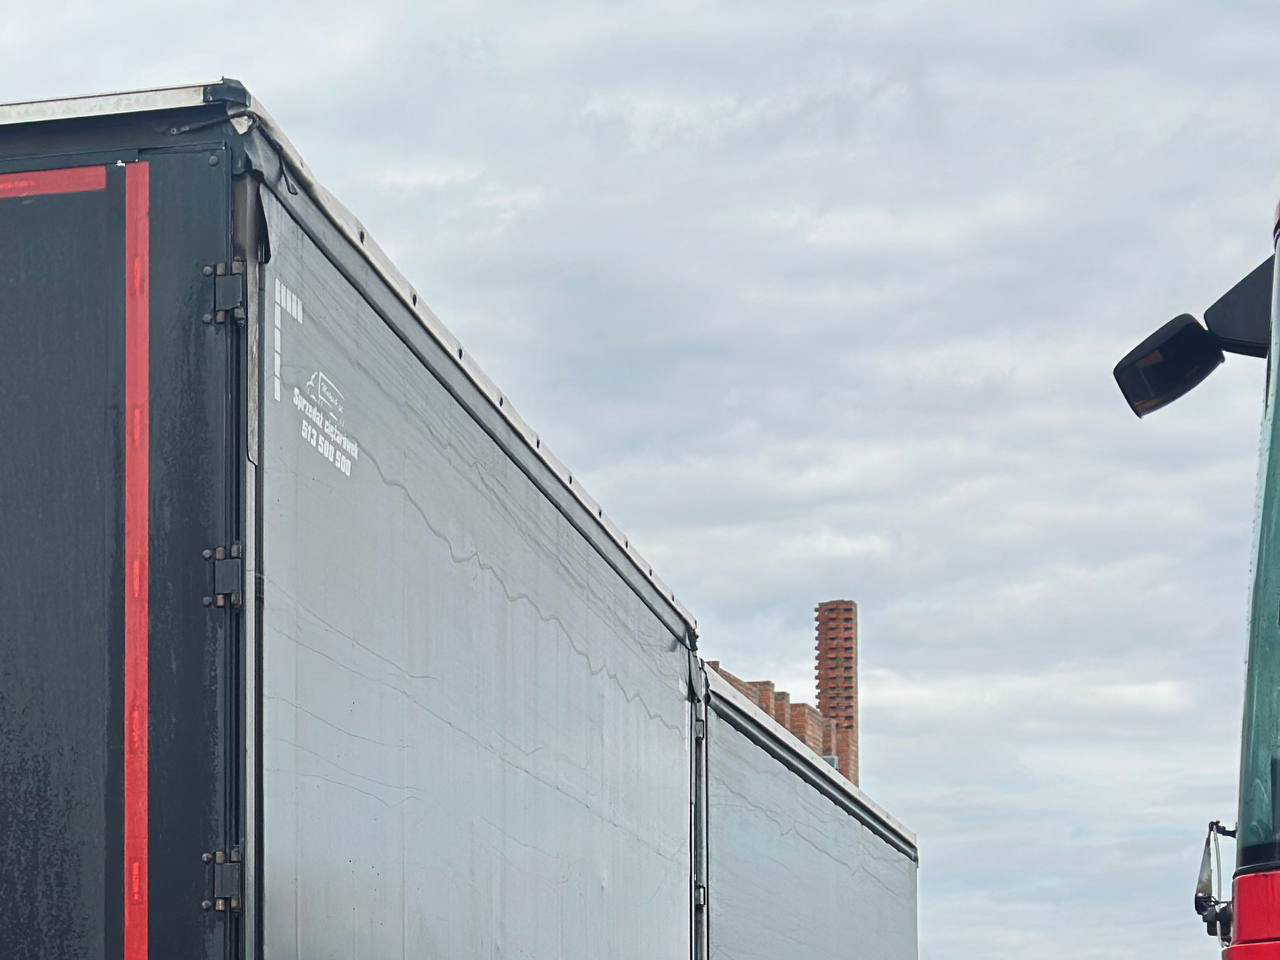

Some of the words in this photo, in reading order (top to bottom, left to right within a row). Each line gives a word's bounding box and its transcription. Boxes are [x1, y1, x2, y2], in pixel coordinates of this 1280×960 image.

[301, 419, 317, 448] 513
[318, 434, 334, 462] 500
[334, 449, 352, 477] 500
